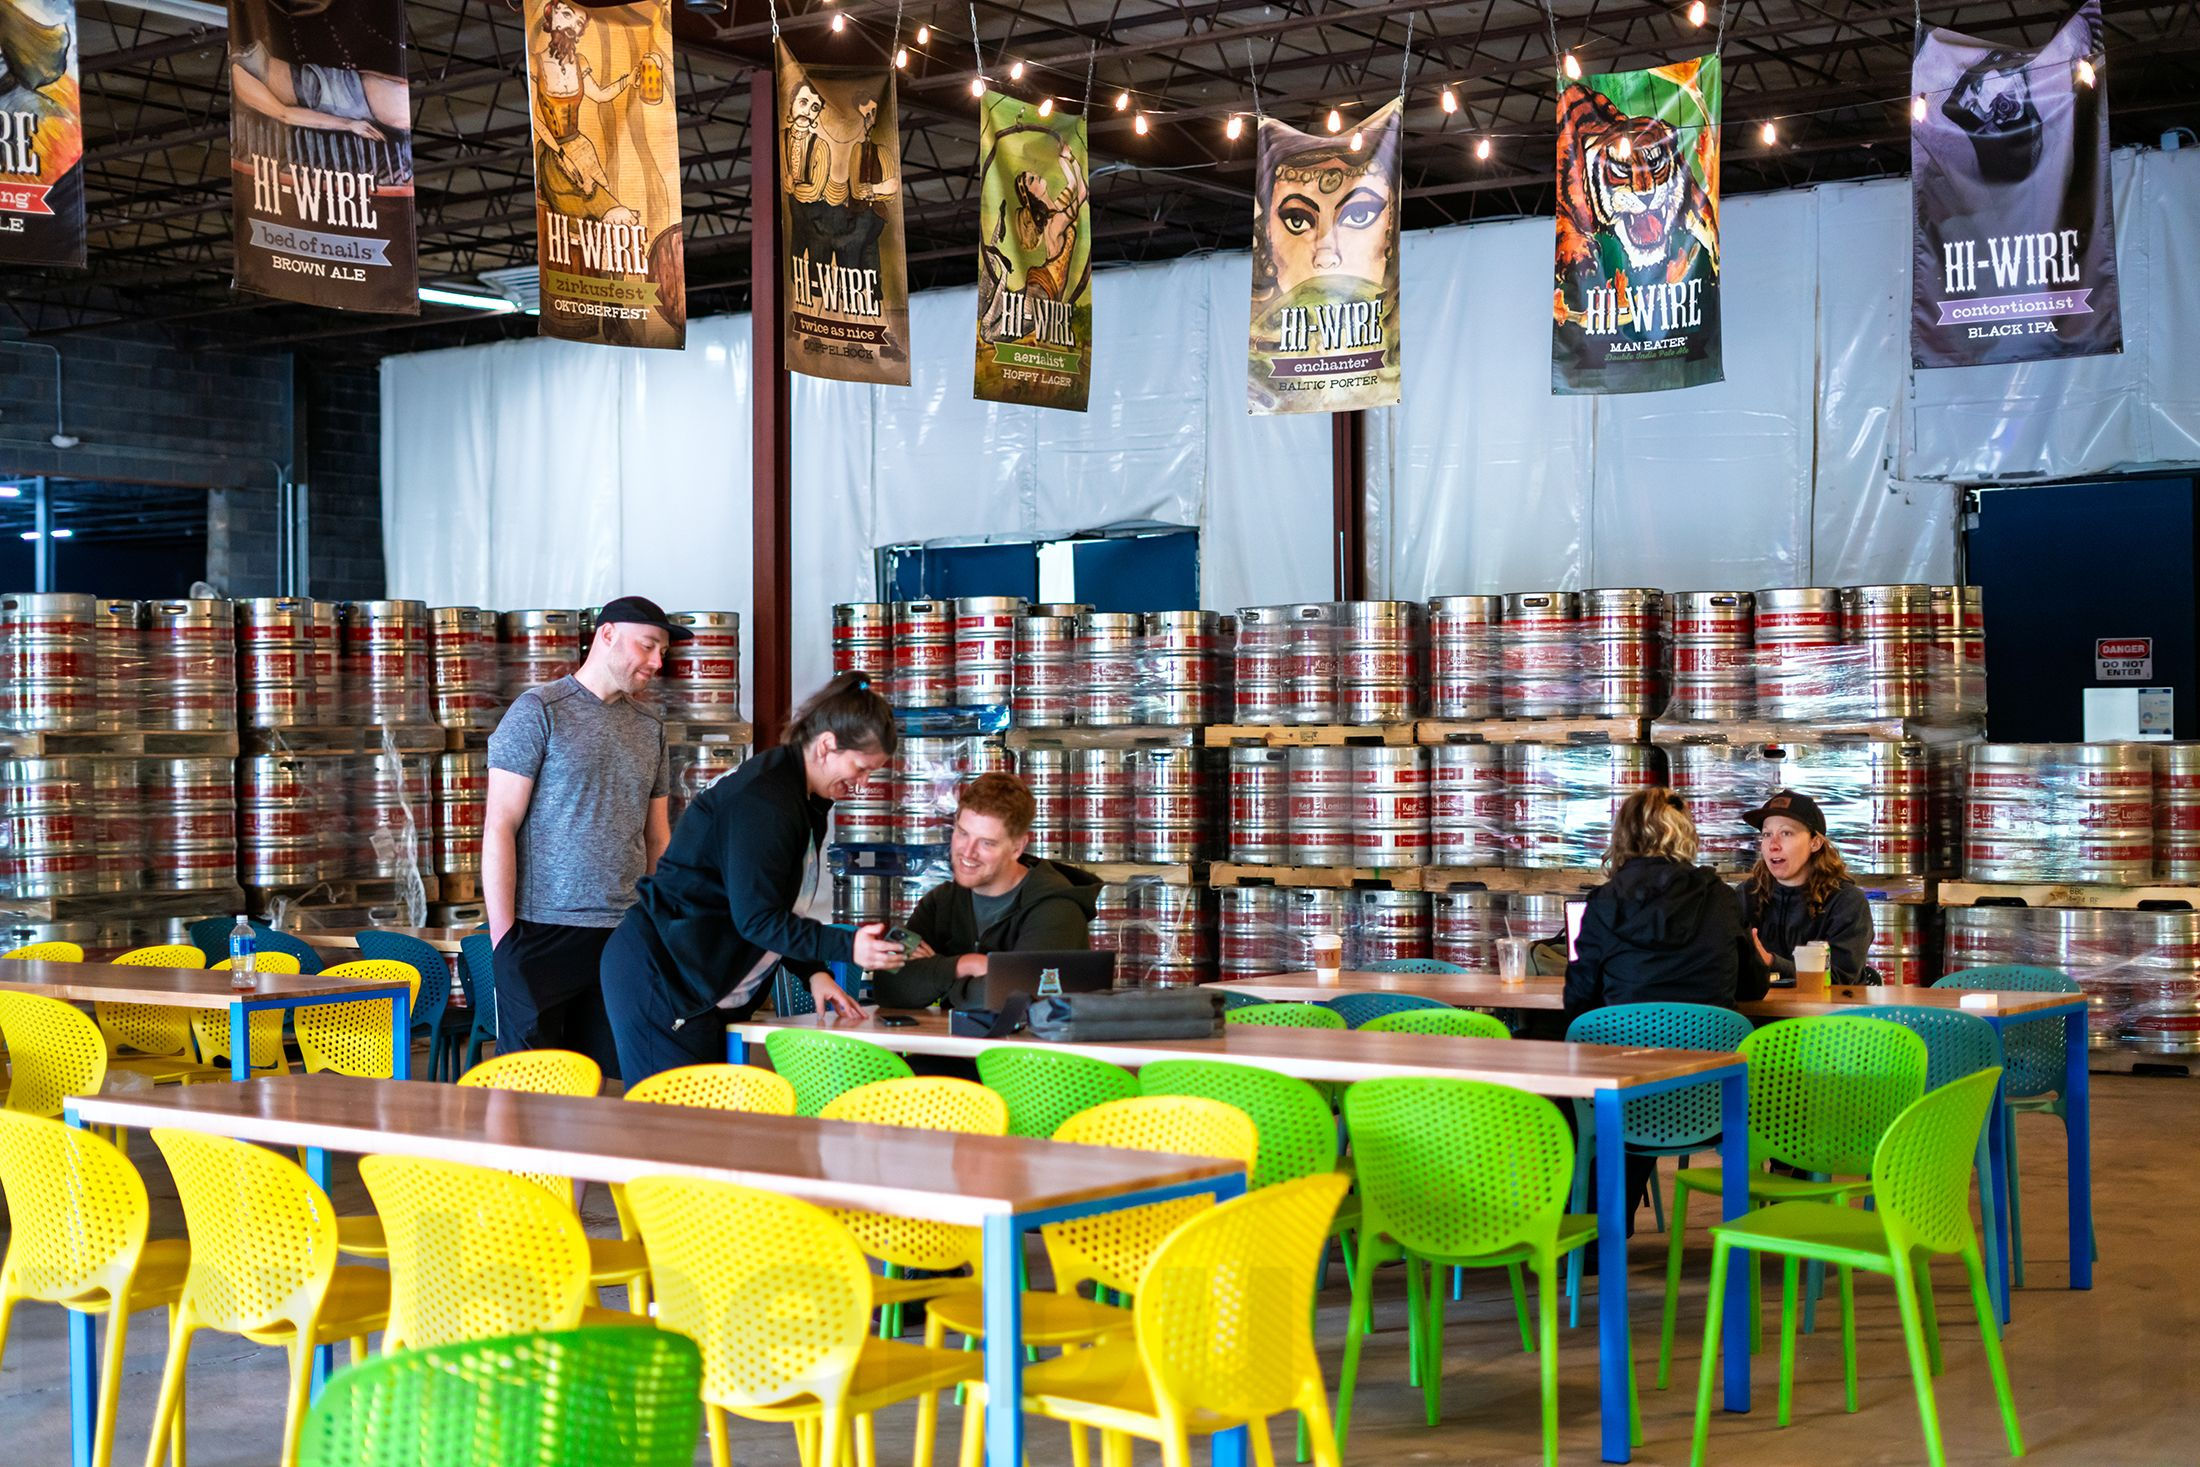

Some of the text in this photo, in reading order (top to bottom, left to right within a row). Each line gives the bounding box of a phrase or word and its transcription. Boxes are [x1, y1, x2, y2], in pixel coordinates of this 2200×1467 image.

[252, 153, 378, 230] HI-WIRE
[261, 226, 373, 261] bed of nails
[546, 212, 649, 275] HI-WIRE
[272, 255, 366, 282] BROWN ALE
[1943, 229, 2081, 294] HI-WIRE
[556, 279, 645, 301] zirkusfest
[792, 255, 880, 317] HI-WIRE
[554, 299, 650, 320] OKTOBERFEST
[1585, 278, 1702, 336] HI-WIRE
[1952, 296, 2074, 319] contortionist
[800, 318, 875, 340] twice as nice
[1000, 291, 1076, 347] HI-WIRE
[1279, 299, 1383, 351] HI-WIRE
[1968, 321, 2058, 339] BLACK IPA
[803, 339, 874, 360] DOPPELBOCK
[1604, 353, 1634, 361] Double
[1636, 351, 1656, 360] India
[1658, 350, 1676, 358] Pale
[1610, 337, 1686, 353] MAN EATER
[1014, 352, 1065, 368] aerialist
[1294, 357, 1370, 374] enchanter
[1003, 368, 1072, 387] HOPPY LAGER
[1279, 375, 1378, 392] BALTIC PORTER
[2102, 644, 2145, 654] DANGER
[2107, 668, 2141, 676] ENTER
[2122, 660, 2145, 668] NOT
